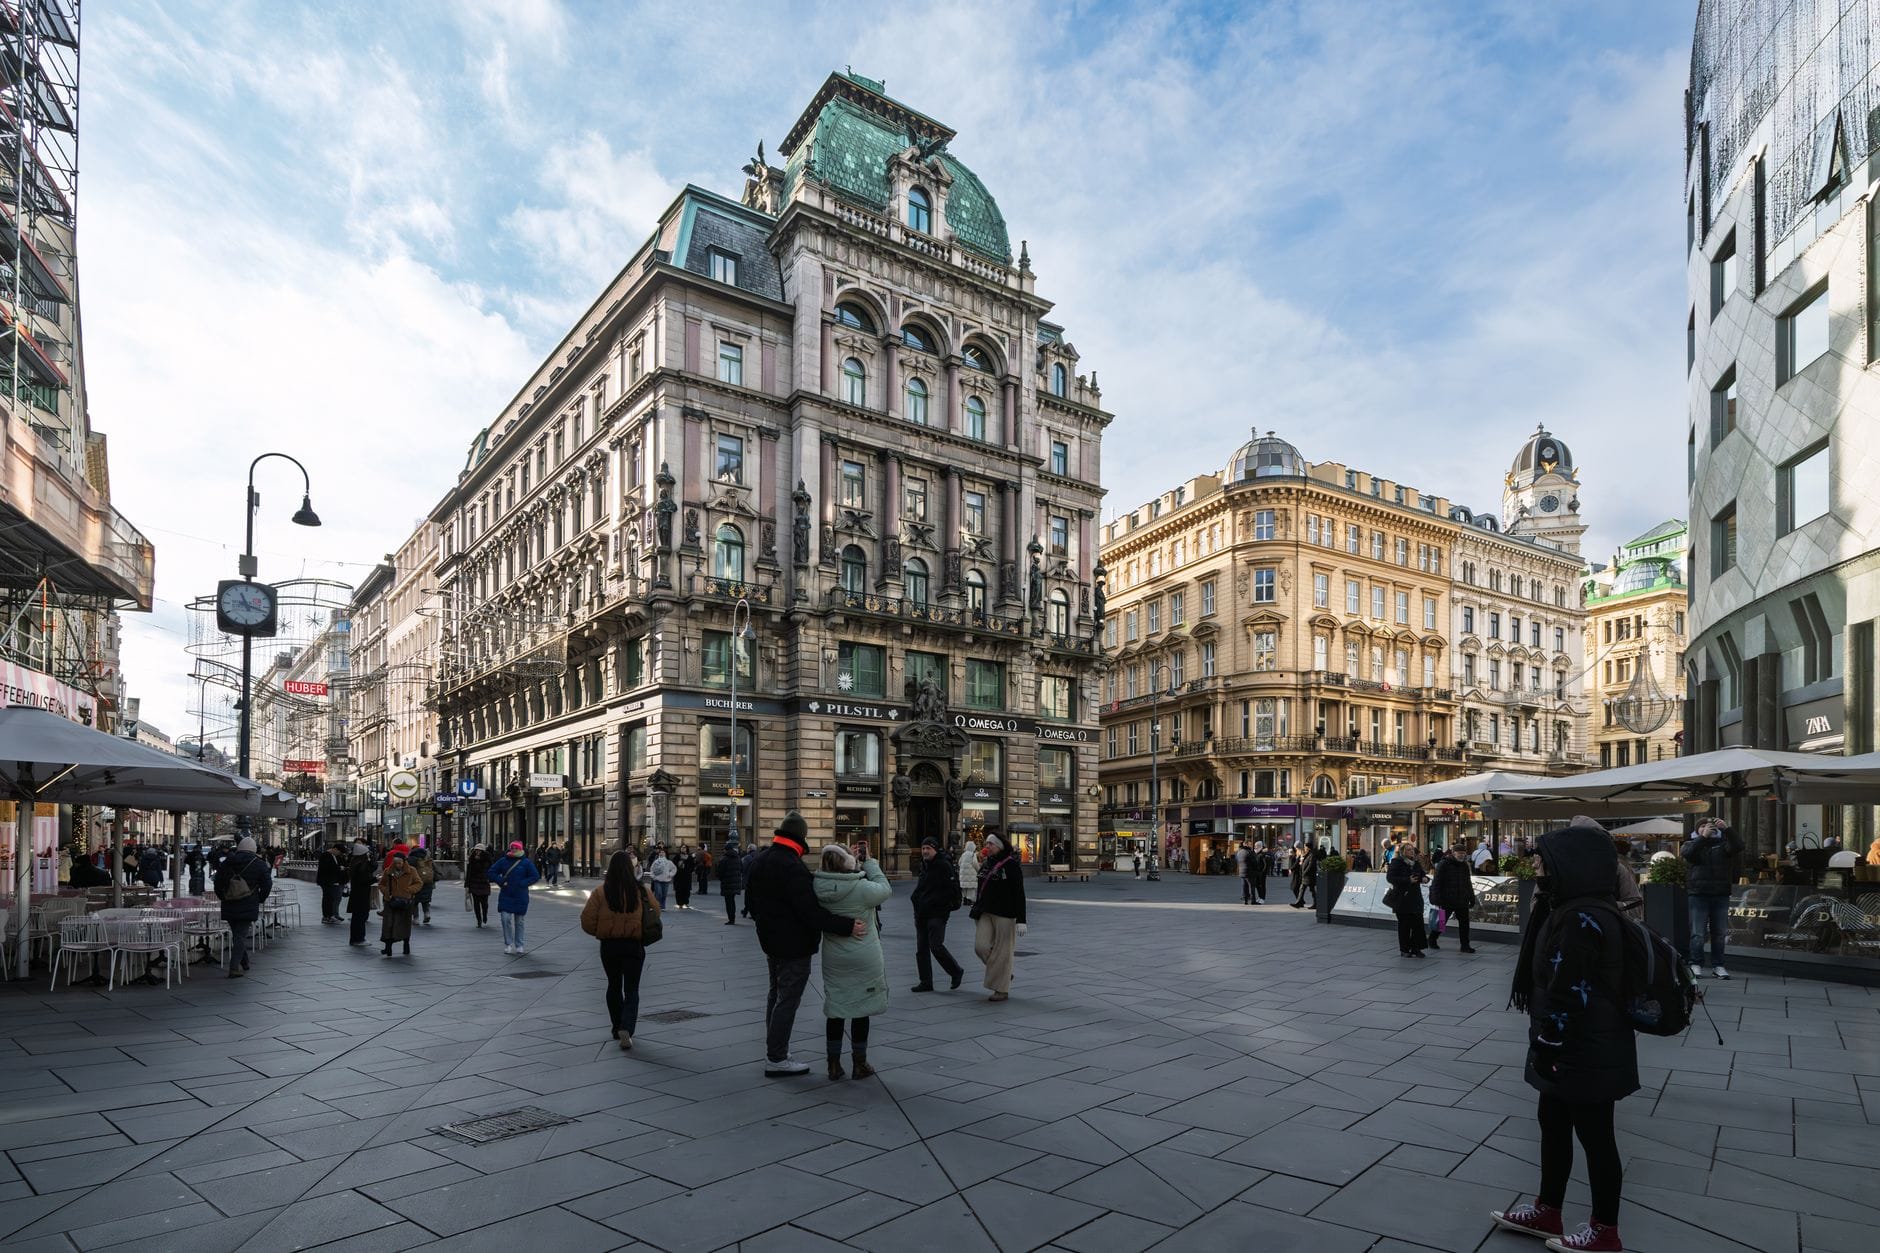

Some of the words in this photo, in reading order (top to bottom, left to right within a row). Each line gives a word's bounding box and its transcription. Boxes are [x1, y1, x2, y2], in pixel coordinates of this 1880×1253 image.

[286, 682, 323, 694] HUBER
[705, 698, 753, 710] BUCHRER
[826, 703, 883, 718] PILSTL
[968, 718, 1004, 730] OMEGA
[1806, 715, 1833, 735] ZARA
[1044, 729, 1076, 741] OMEGA
[462, 782, 475, 794] U
[1484, 893, 1519, 903] DEMEL
